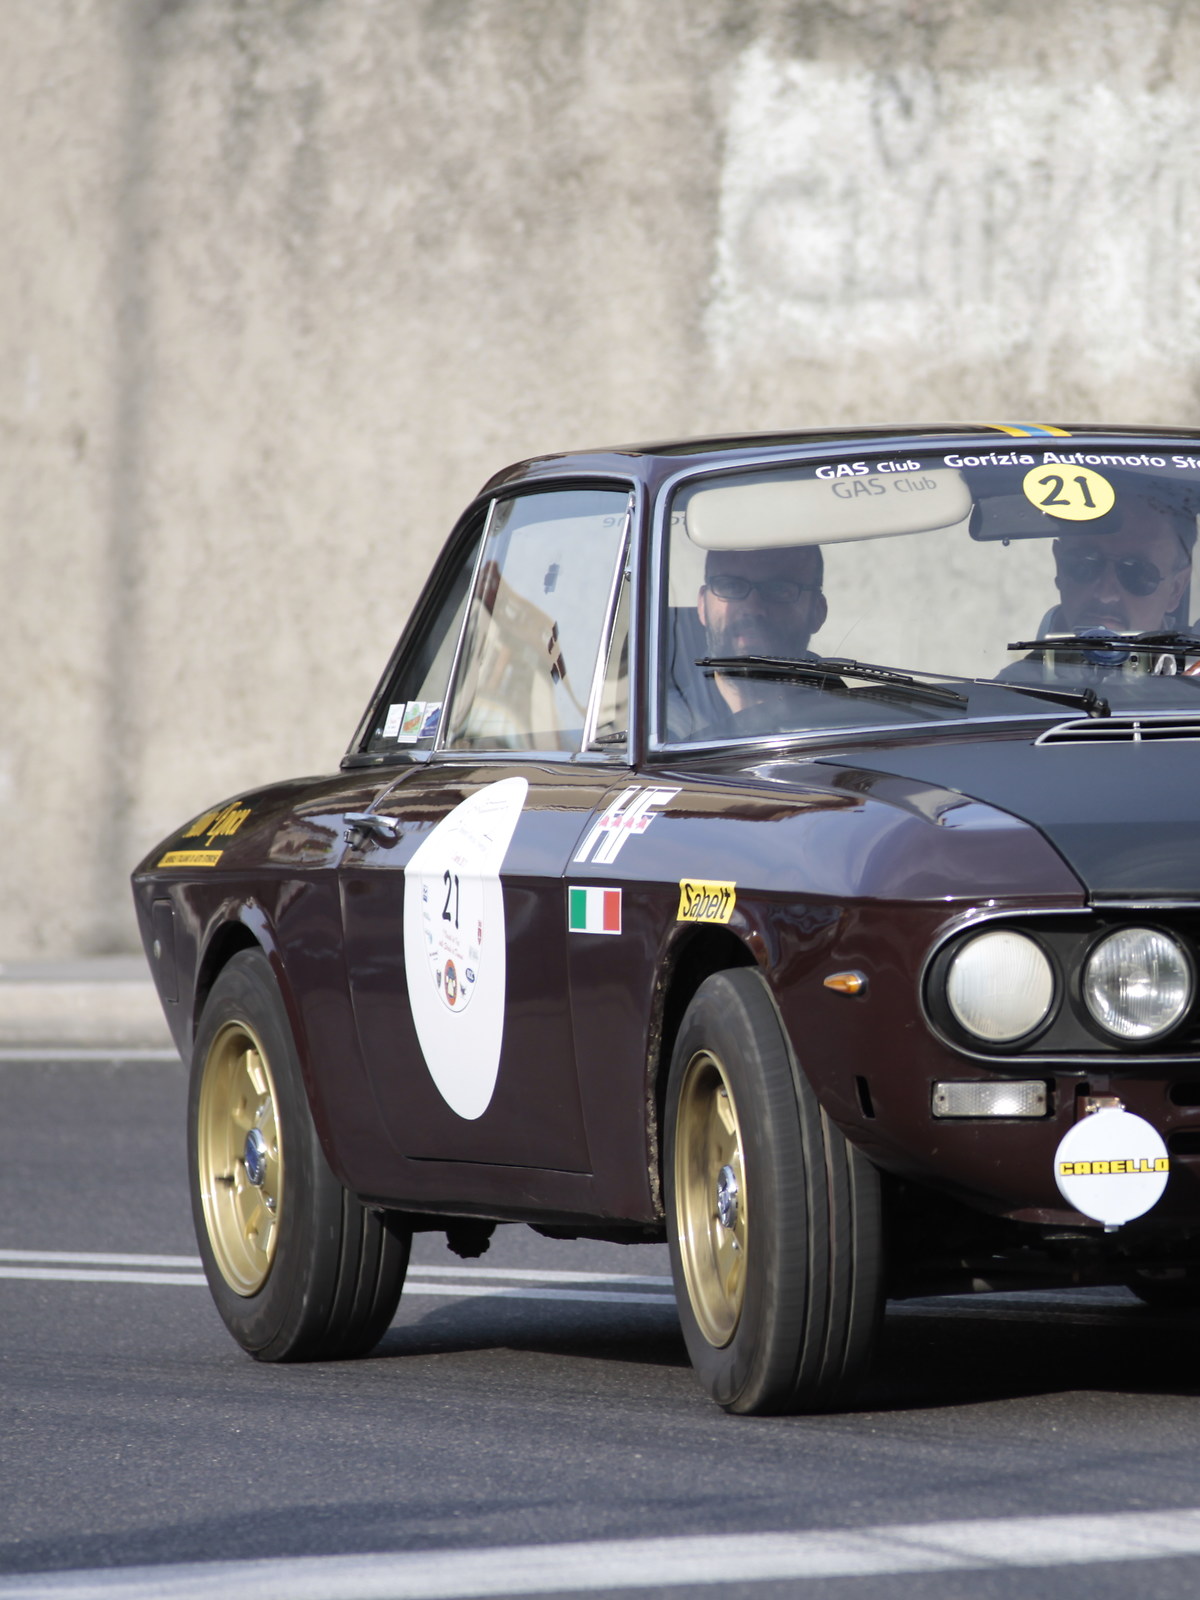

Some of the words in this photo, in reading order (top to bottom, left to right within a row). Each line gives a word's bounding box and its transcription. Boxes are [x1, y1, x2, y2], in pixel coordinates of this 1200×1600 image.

[815, 461, 870, 480] GAS
[876, 460, 921, 473] Club
[943, 451, 1035, 468] Gorizia
[1042, 451, 1166, 468] Automoto
[831, 478, 887, 499] GAS
[893, 476, 938, 493] Club
[1037, 474, 1097, 509] 21
[573, 785, 684, 864] HF
[442, 869, 459, 930] 21
[682, 882, 731, 920] Sabelt
[1059, 1158, 1170, 1176] CARELLO
